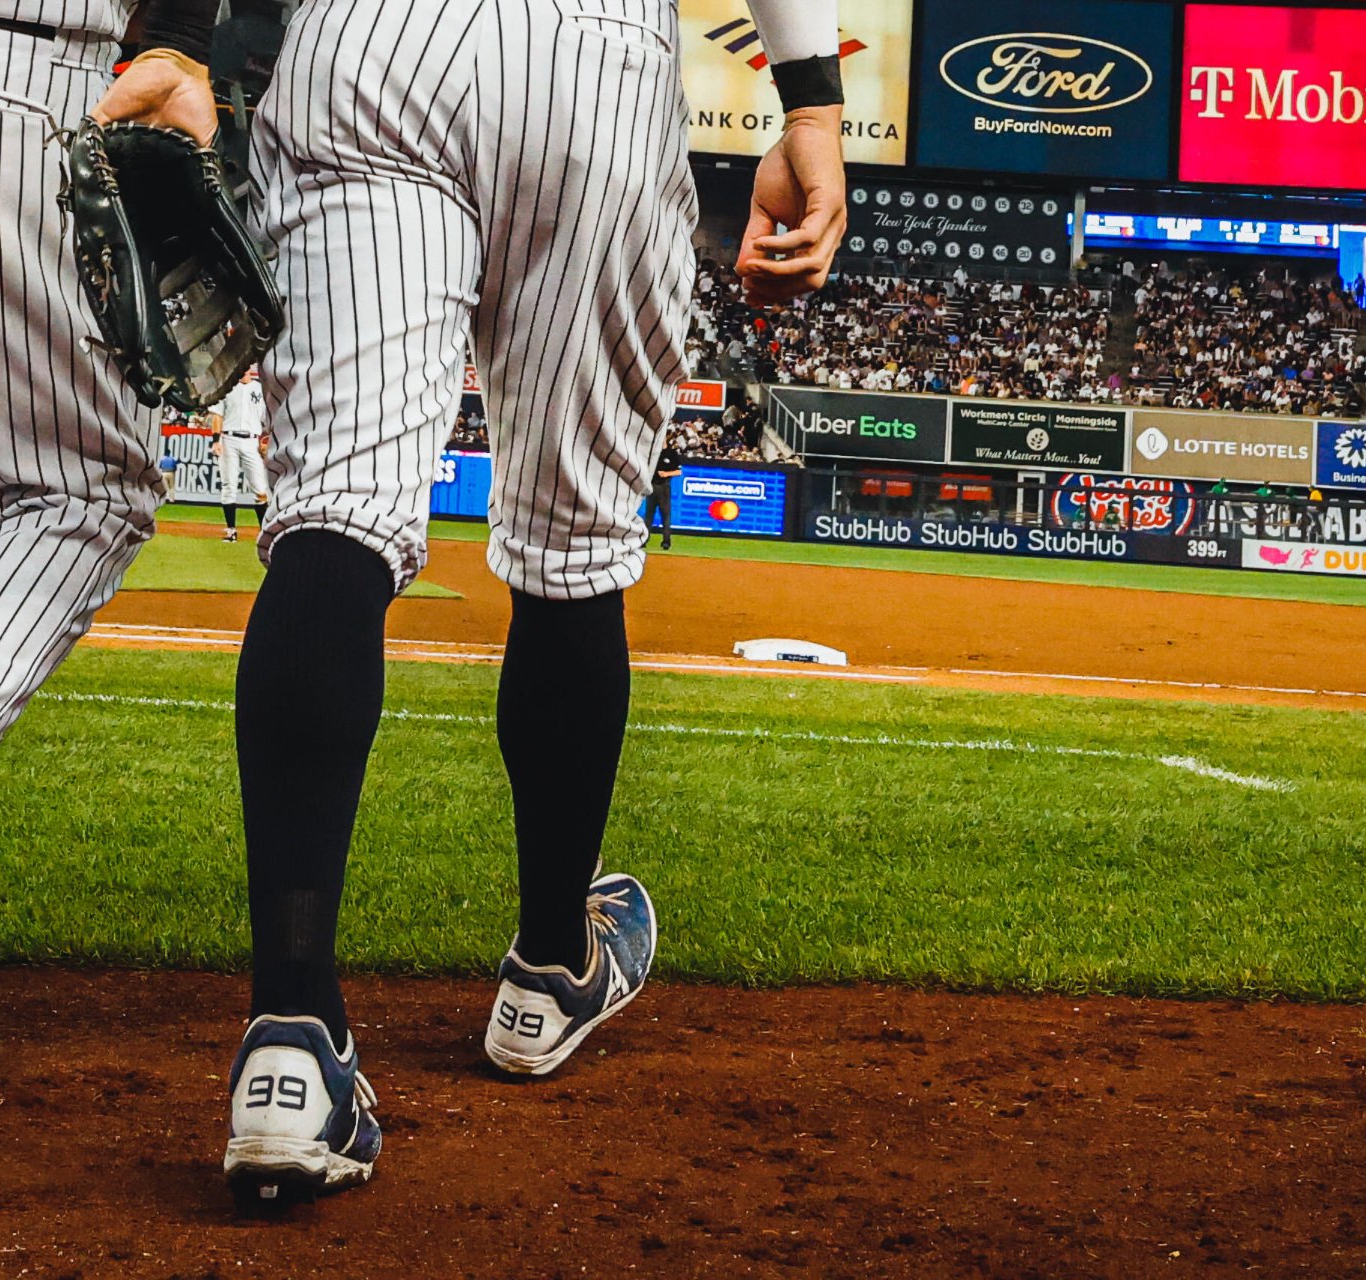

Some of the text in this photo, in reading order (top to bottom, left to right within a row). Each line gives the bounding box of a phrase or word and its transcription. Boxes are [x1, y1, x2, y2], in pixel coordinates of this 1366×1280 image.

[977, 42, 1116, 101] Ford
[741, 114, 773, 130] OF
[974, 117, 1112, 137] BuyFordNow.com
[873, 211, 987, 236] New York Yankees
[799, 411, 917, 439] Uber Eats
[960, 409, 1046, 422] Workmen's Circle
[1056, 415, 1117, 427] Morningside
[975, 447, 1002, 459] What
[1004, 449, 1041, 461] Matters
[1078, 454, 1102, 465] You!
[1173, 438, 1309, 460] LOTTE HOTELS
[815, 515, 1126, 556] StubHub StubHub StubHub
[497, 1000, 544, 1038] 99
[246, 1075, 307, 1111] 99
